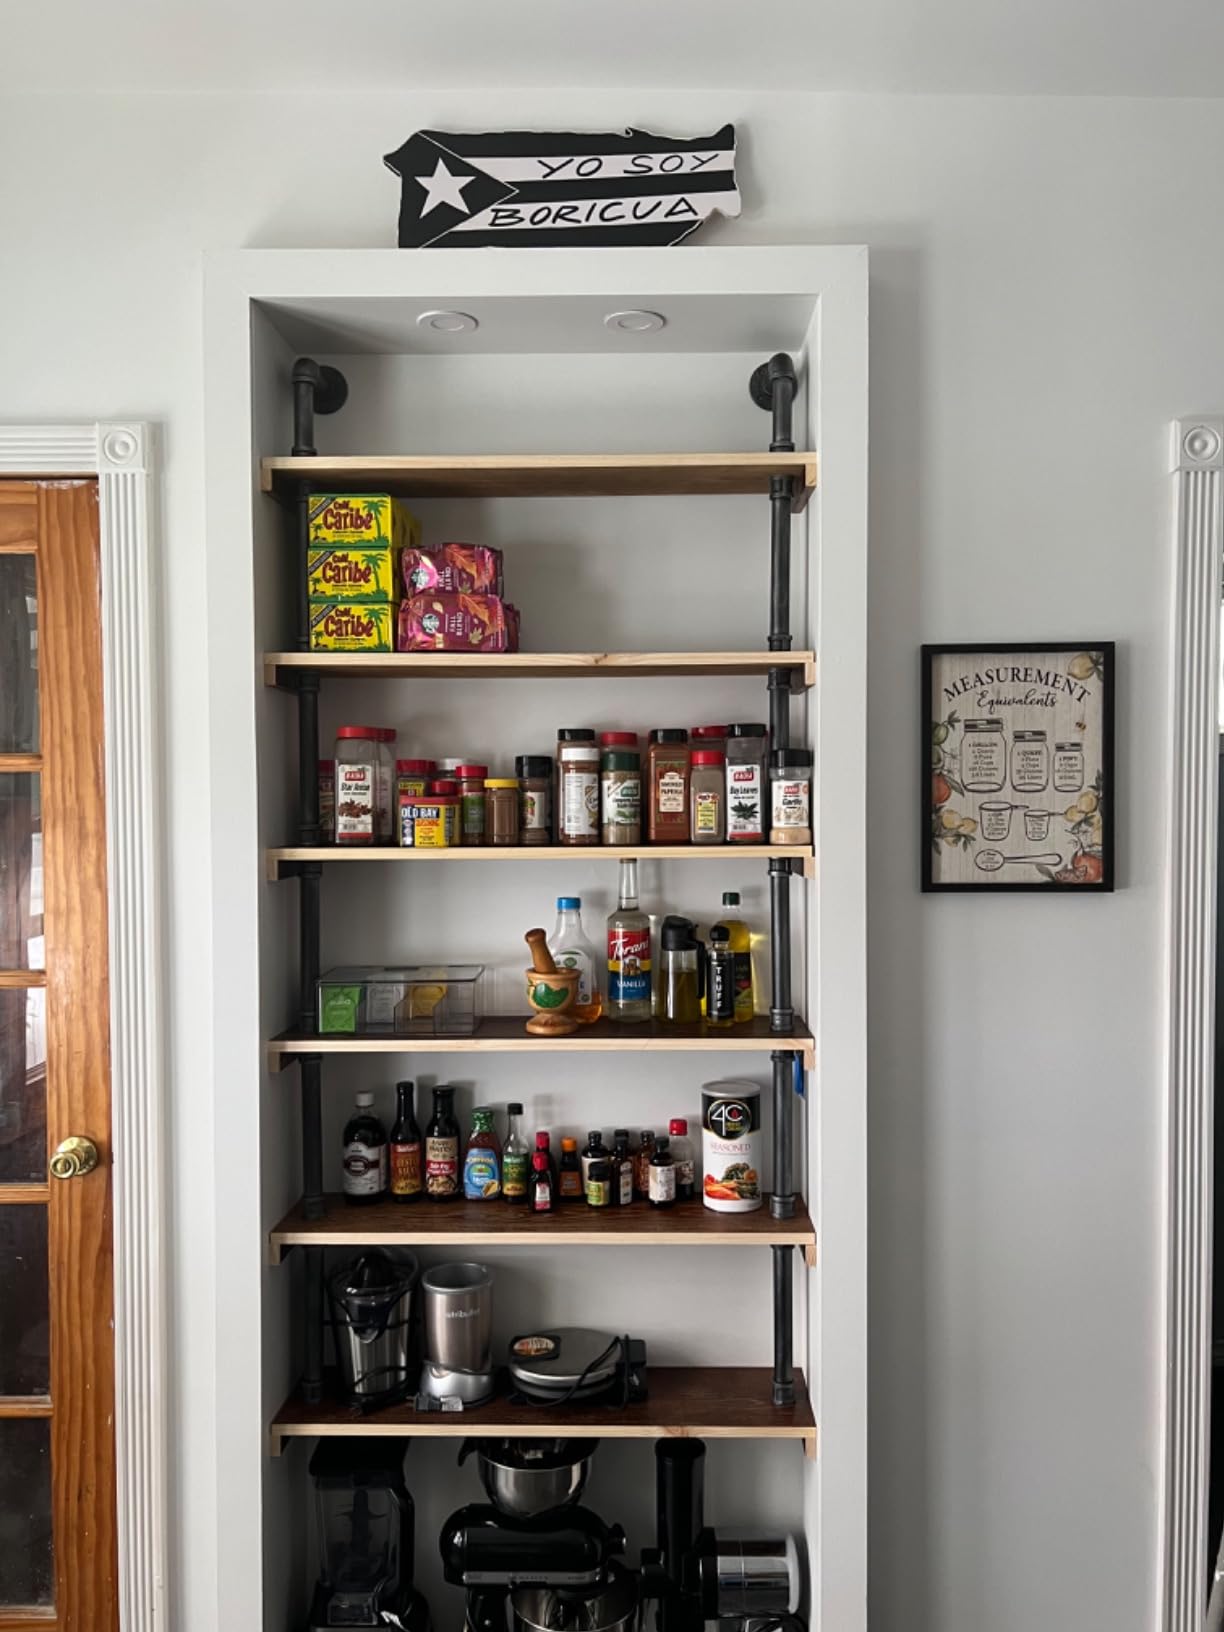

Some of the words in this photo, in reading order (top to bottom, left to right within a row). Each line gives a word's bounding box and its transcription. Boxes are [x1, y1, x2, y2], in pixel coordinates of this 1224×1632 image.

[537, 156, 604, 179] YO
[623, 152, 719, 174] SOY
[488, 196, 699, 227] BORICUA
[323, 507, 373, 530] Caribe
[321, 560, 372, 583] Caribe
[324, 614, 375, 637] Caribe
[943, 666, 1092, 703] MEASUREMENT
[976, 688, 1057, 715] Equivalents
[730, 786, 740, 797] Bay
[740, 786, 759, 794] Leaves
[401, 807, 418, 818] OLD
[419, 808, 437, 818] BAY
[711, 1104, 744, 1136] 4C
[710, 1143, 751, 1153] SEASONED
